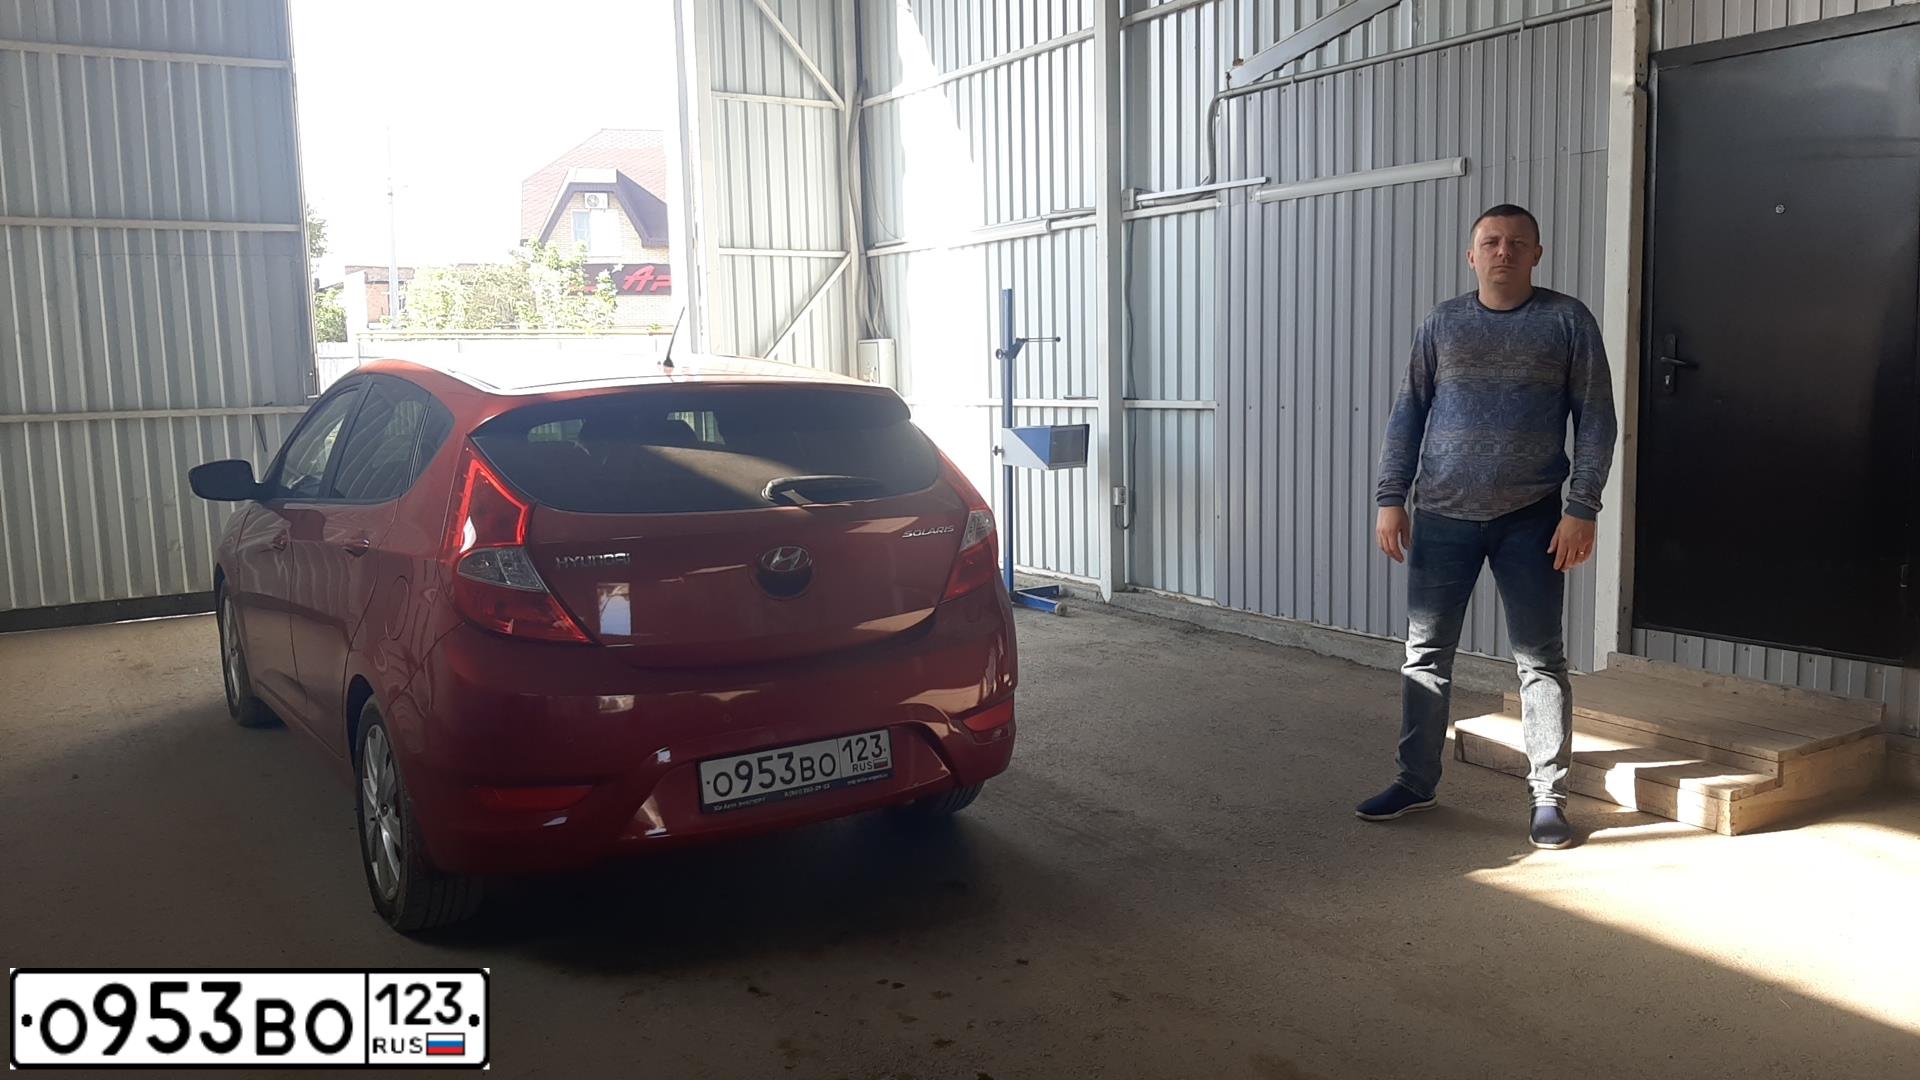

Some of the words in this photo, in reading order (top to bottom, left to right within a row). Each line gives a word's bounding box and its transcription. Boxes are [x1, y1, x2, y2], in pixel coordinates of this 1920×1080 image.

[902, 525, 954, 538] SOLARIS
[842, 734, 882, 763] 123
[852, 761, 873, 773] RUS
